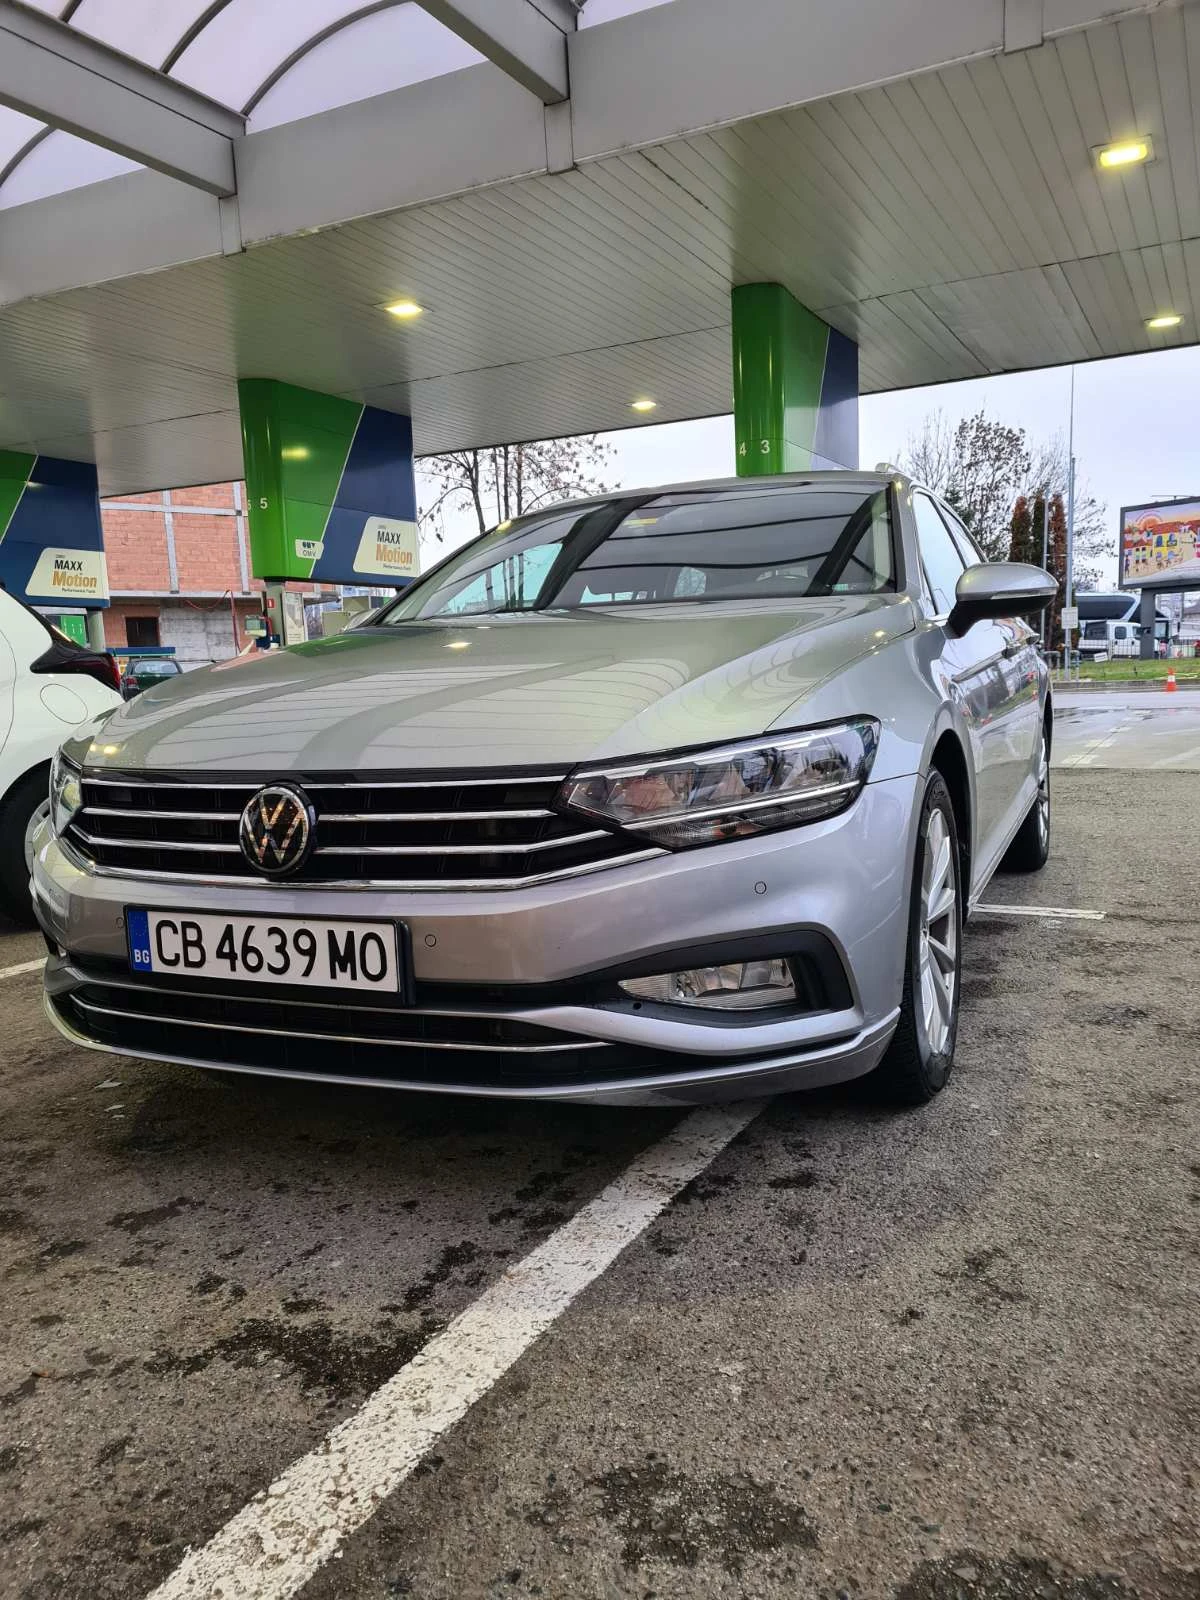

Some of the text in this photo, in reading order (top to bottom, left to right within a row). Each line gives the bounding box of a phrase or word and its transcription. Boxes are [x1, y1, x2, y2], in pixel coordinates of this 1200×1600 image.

[739, 440, 770, 456] 4 3
[260, 498, 268, 509] 5
[377, 530, 401, 545] MAXX
[376, 544, 413, 565] Motion
[54, 559, 83, 571] MAXX
[52, 570, 97, 588] Motion
[133, 949, 150, 963] BG
[155, 919, 388, 982] CB 4639 MO
